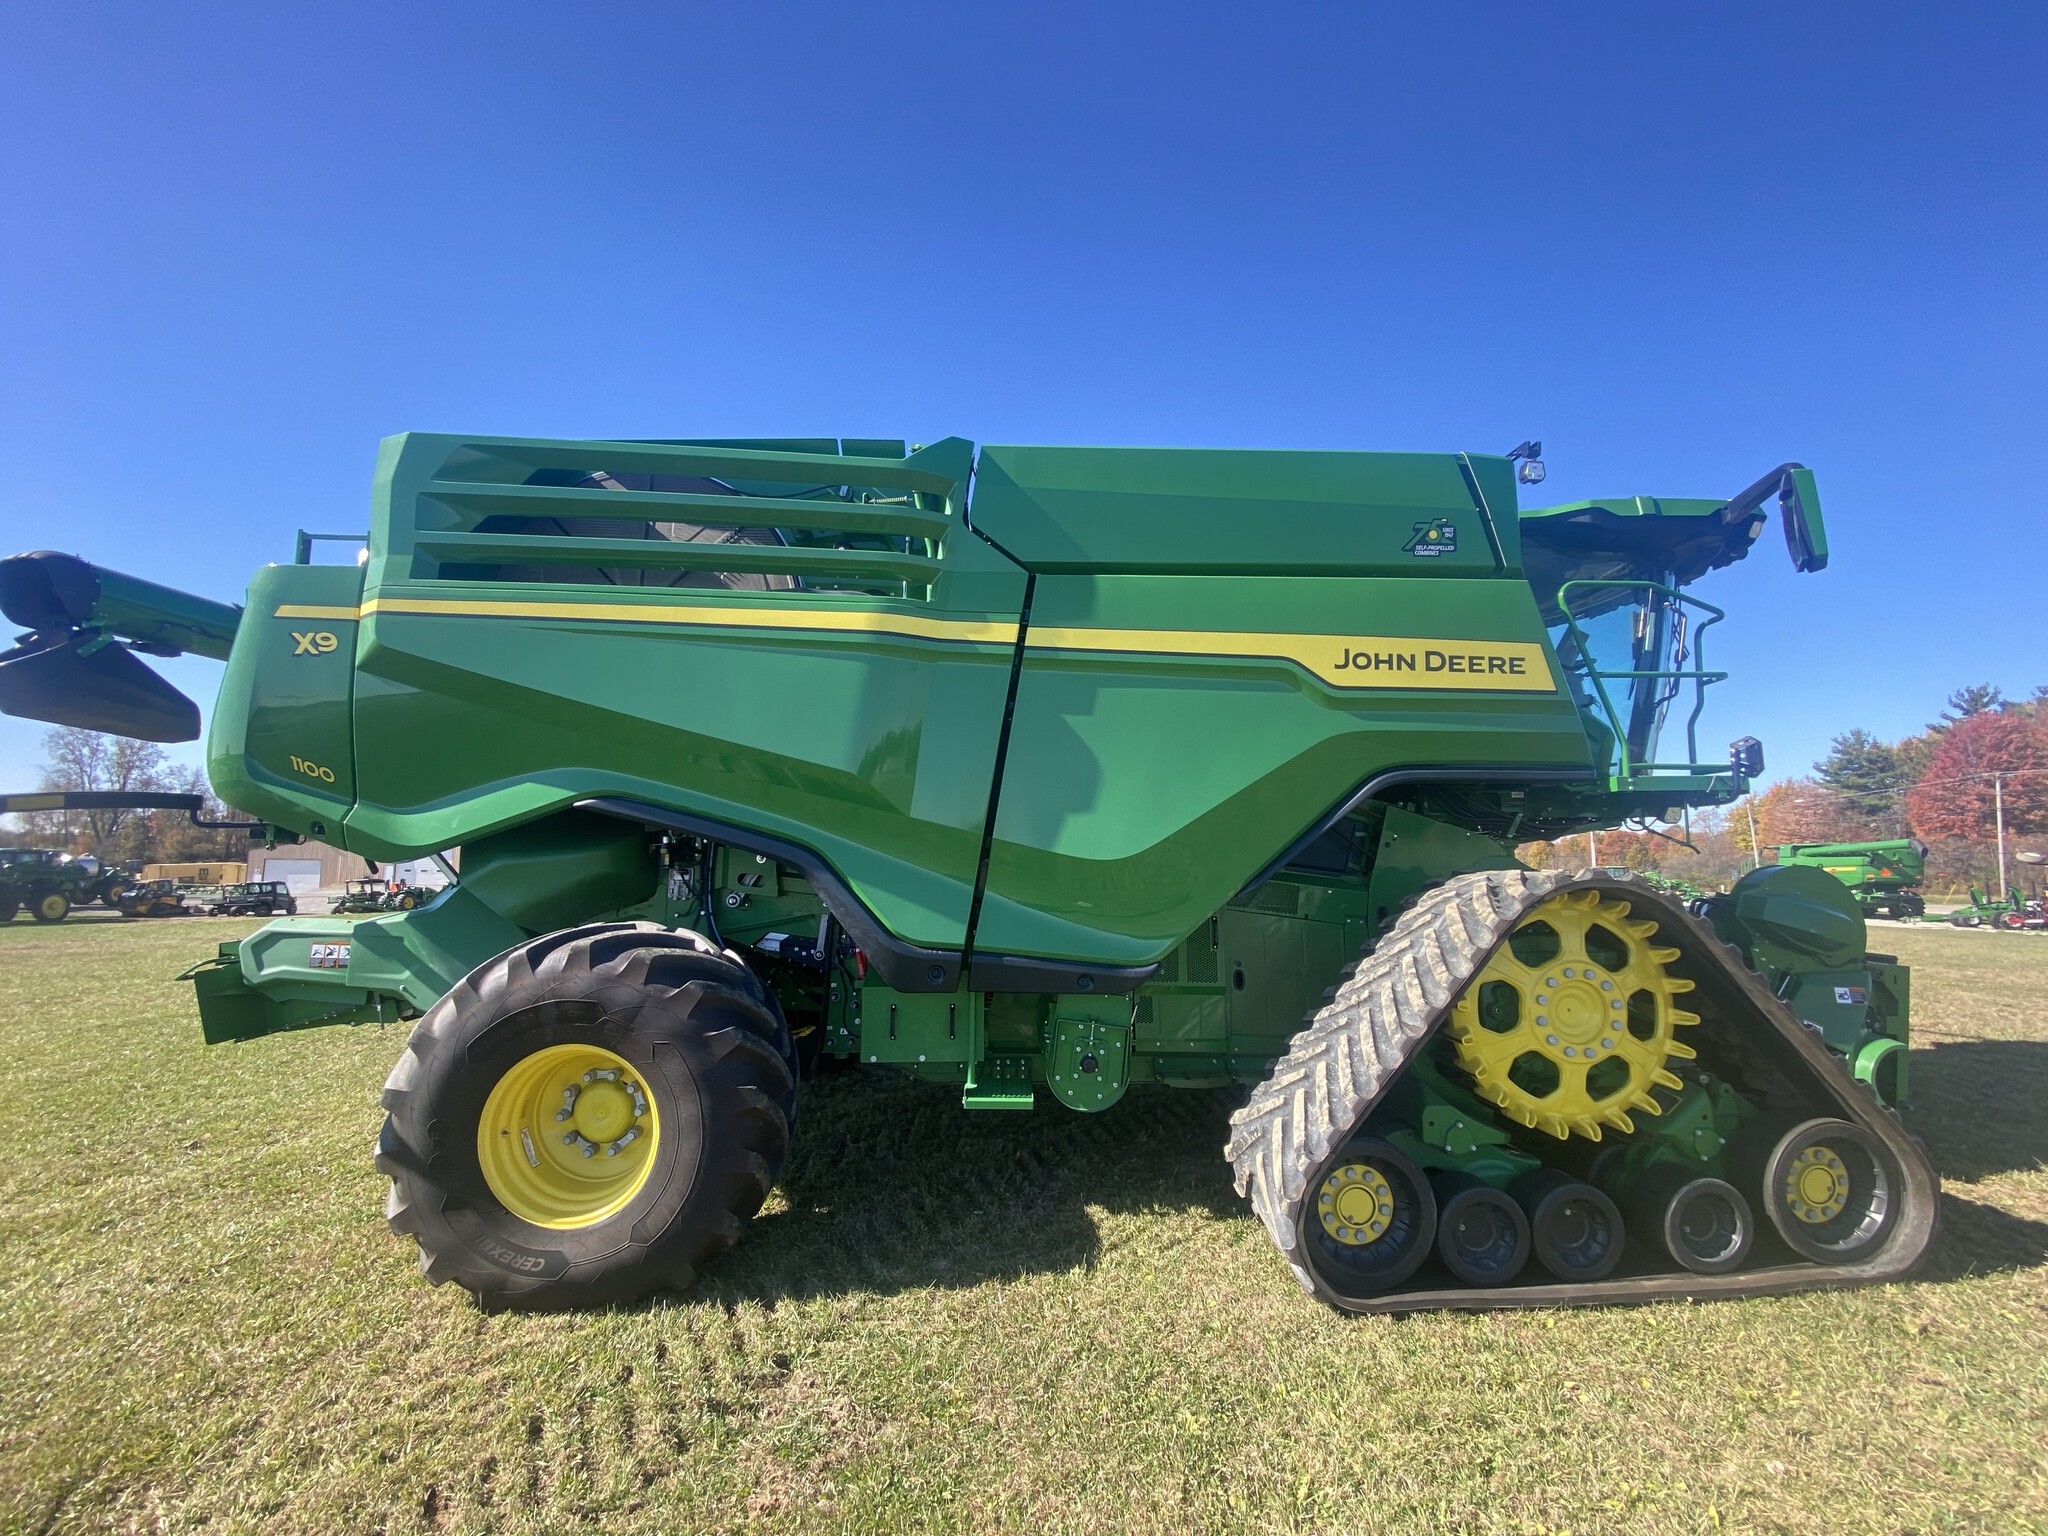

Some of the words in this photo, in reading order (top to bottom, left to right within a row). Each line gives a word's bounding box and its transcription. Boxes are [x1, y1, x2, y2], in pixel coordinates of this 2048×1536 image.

[290, 631, 339, 656] X9
[1334, 648, 1416, 671] JOHN
[1424, 650, 1526, 675] DEERE
[289, 754, 336, 783] 1100
